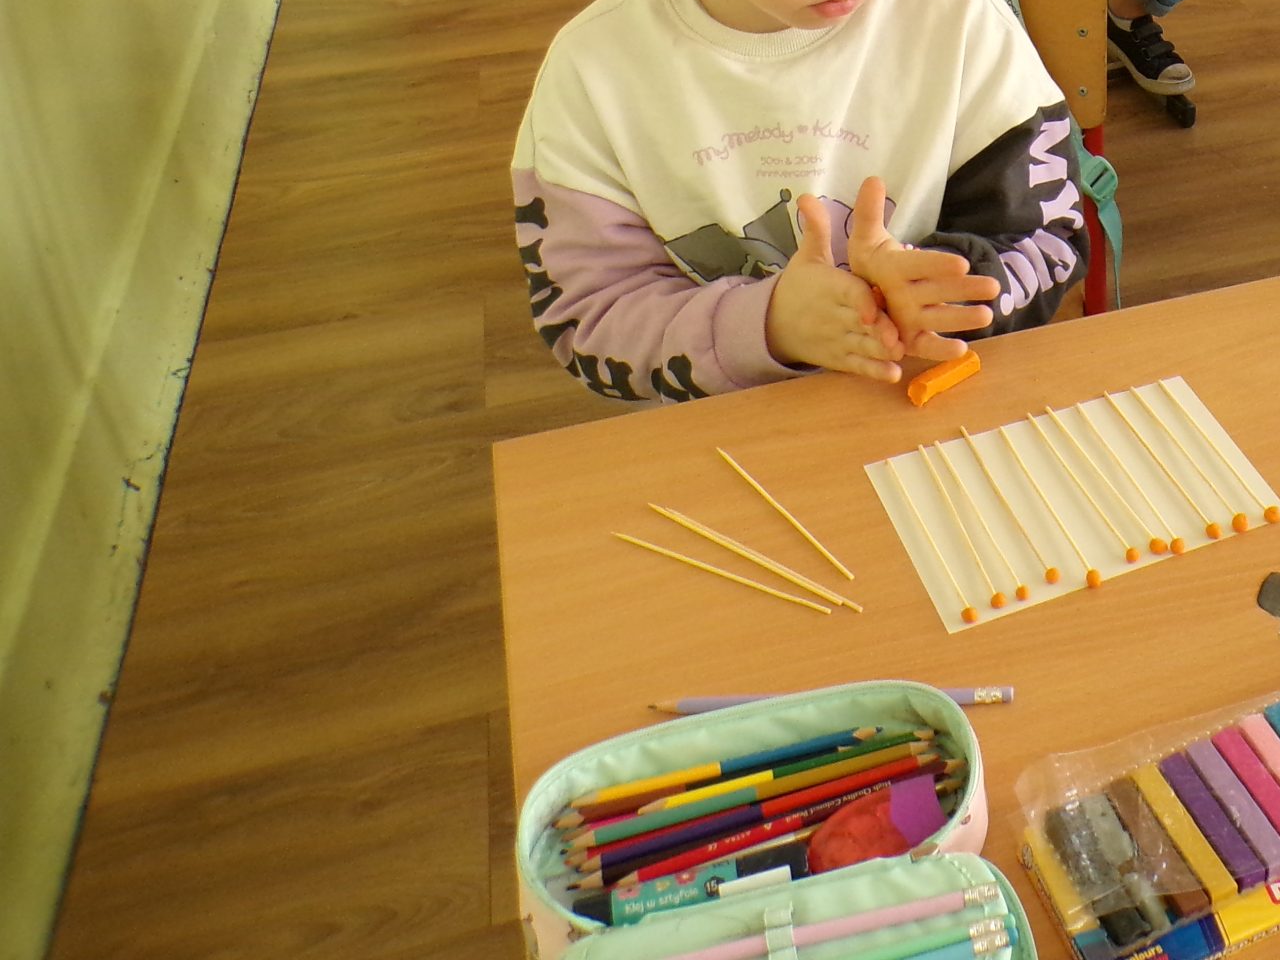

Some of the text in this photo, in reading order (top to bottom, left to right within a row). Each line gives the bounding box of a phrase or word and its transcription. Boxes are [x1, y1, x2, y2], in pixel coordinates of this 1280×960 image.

[692, 144, 730, 166] My
[721, 122, 794, 150] Melody
[872, 780, 893, 792] High
[842, 787, 872, 803] Quality
[625, 902, 645, 915] Klej
